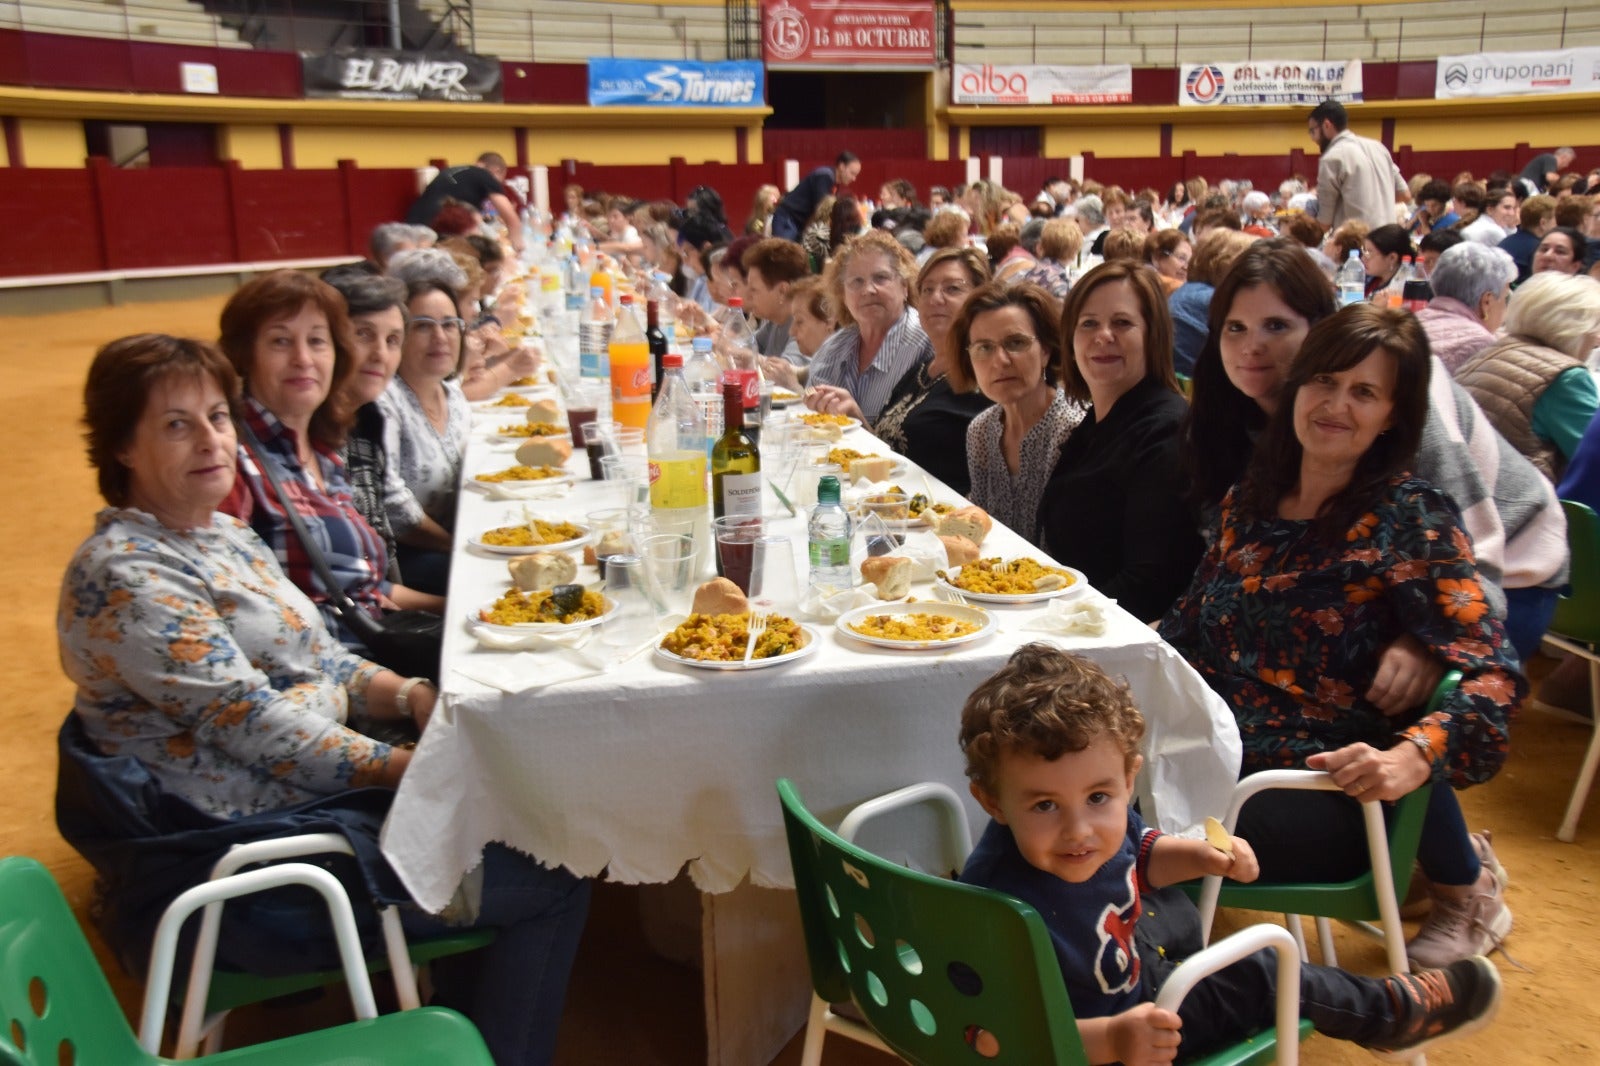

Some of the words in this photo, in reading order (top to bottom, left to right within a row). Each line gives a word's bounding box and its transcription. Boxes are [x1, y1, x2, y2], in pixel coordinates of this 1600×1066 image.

[834, 14, 876, 25] ASOCIACIÓN
[877, 16, 911, 26] TAURINA
[813, 28, 830, 46] 15
[835, 31, 852, 46] DE
[856, 28, 930, 48] OCTUBRE
[342, 59, 376, 88] EL
[373, 56, 468, 93] BUNKER
[961, 64, 1027, 95] alba
[1274, 66, 1301, 79] FON
[1306, 67, 1345, 81] ALBA
[1472, 58, 1574, 84] gruponani
[680, 71, 756, 102] Tormes
